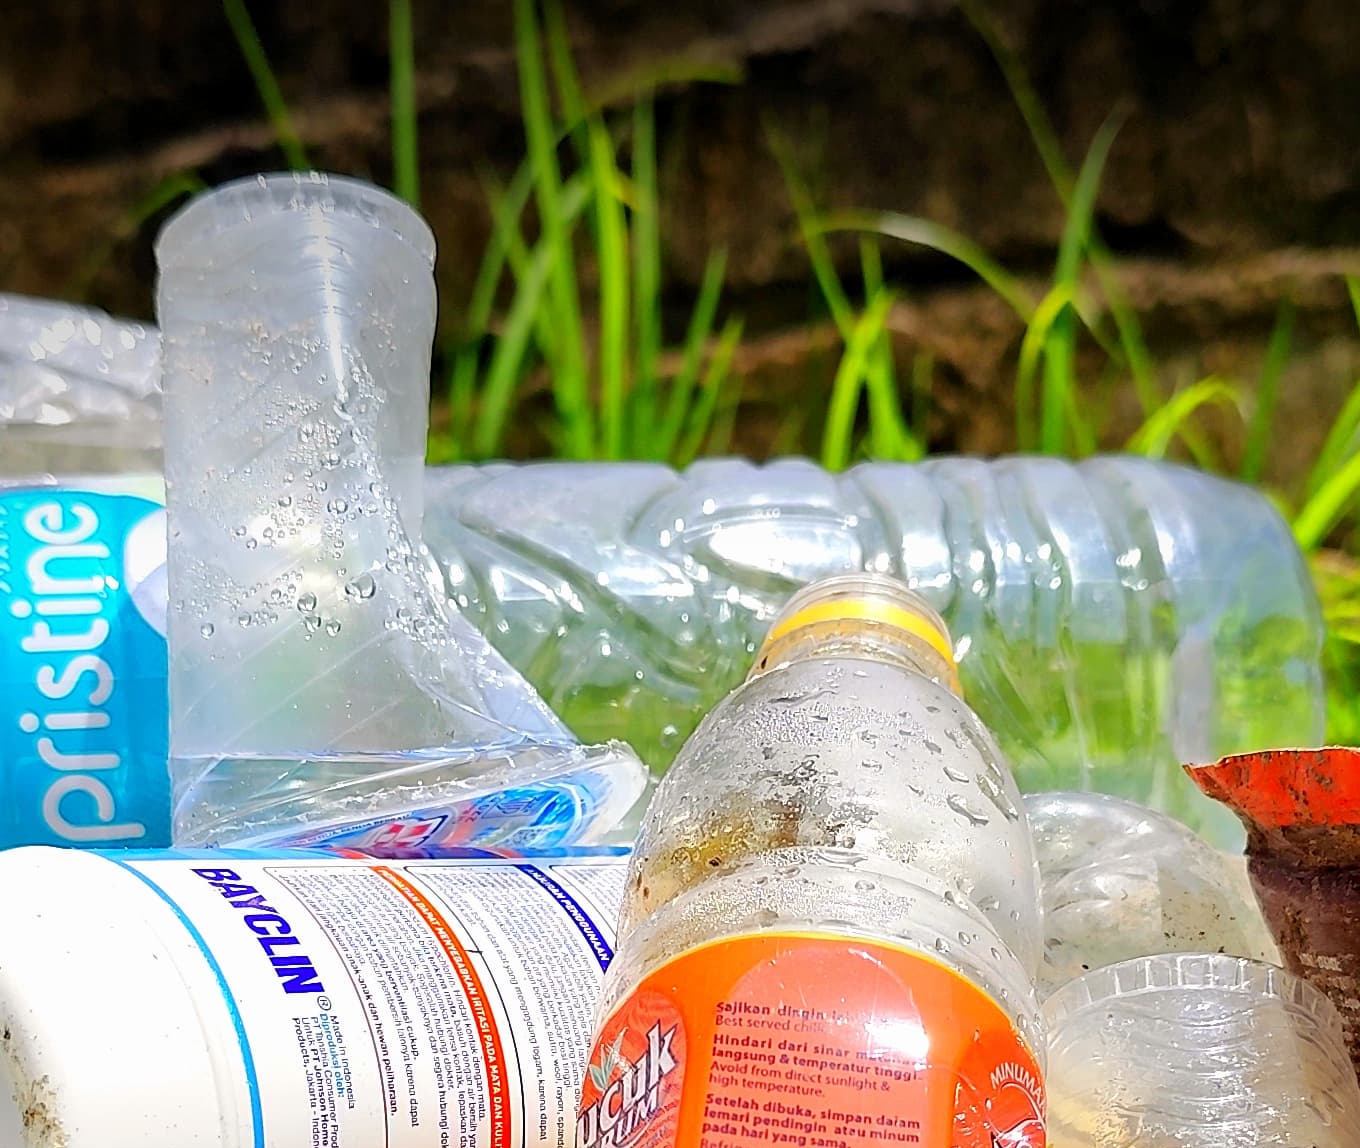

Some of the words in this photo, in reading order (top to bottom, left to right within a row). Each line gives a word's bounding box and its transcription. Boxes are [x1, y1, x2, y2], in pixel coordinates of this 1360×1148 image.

[12, 499, 146, 842] pristine
[191, 868, 326, 993] BAYCLIN
[471, 994, 490, 1032] IRITASI
[319, 1012, 339, 1069] Diproduksi
[483, 1034, 496, 1062] PADA
[713, 1033, 771, 1049] Hindari
[777, 1039, 807, 1052] dari
[813, 1044, 850, 1057] sinar
[330, 1015, 343, 1043] Made
[340, 1058, 357, 1109] Indonesia
[710, 1061, 748, 1075] Avoid
[750, 1066, 782, 1078] from
[825, 1074, 877, 1092] sunlight
[712, 1046, 775, 1063] langsung
[792, 1056, 870, 1075] temperatur
[489, 1064, 501, 1093] MATA
[709, 1073, 738, 1087] high
[990, 1062, 1044, 1105] MINUMA
[312, 1064, 328, 1111] Johnson
[321, 1113, 330, 1146] Home
[406, 1097, 421, 1127] dapat
[438, 1090, 447, 1130] hubungi
[492, 1096, 503, 1118] DAN
[705, 1094, 759, 1109] Setelah
[762, 1101, 816, 1118] dibuka,
[819, 1109, 872, 1126] simpan
[701, 1123, 736, 1137] pada
[740, 1126, 769, 1138] hari
[771, 1131, 806, 1146] yang
[703, 1107, 749, 1123] lemari
[752, 1113, 827, 1134] pendingin
[833, 1125, 866, 1137] atau
[869, 1128, 919, 1142] minum
